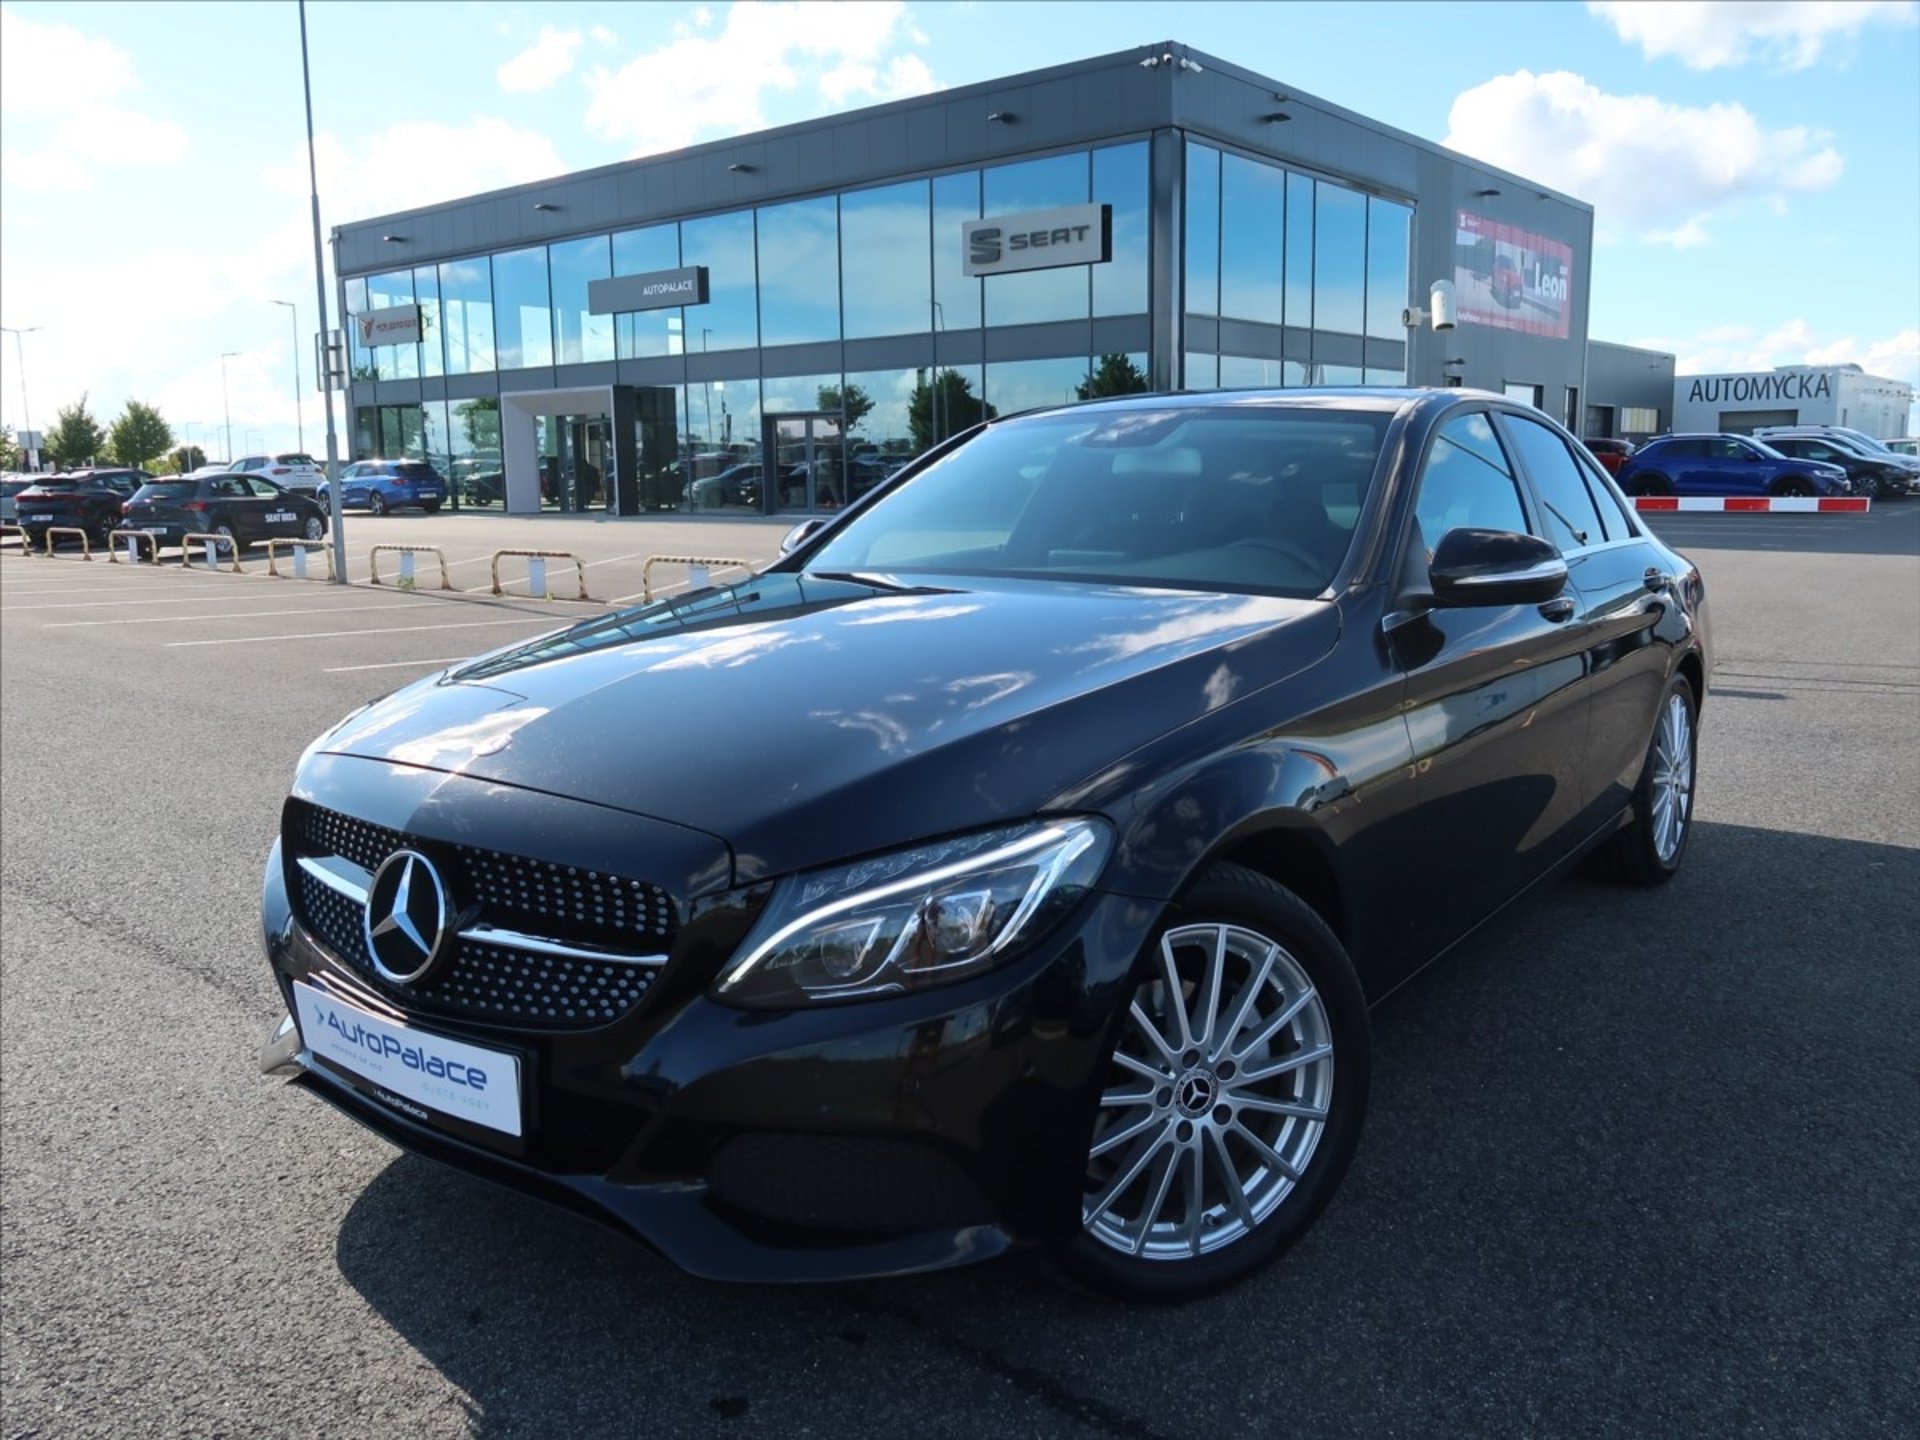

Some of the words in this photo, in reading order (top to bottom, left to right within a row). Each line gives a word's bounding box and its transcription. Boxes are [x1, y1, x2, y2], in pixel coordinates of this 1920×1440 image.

[1009, 225, 1091, 250] SEAT
[643, 280, 693, 296] AUTOPALACE
[1534, 262, 1567, 301] Leon
[1689, 371, 1831, 402] AUTOMYČKA
[327, 1010, 487, 1090] AutoPalace
